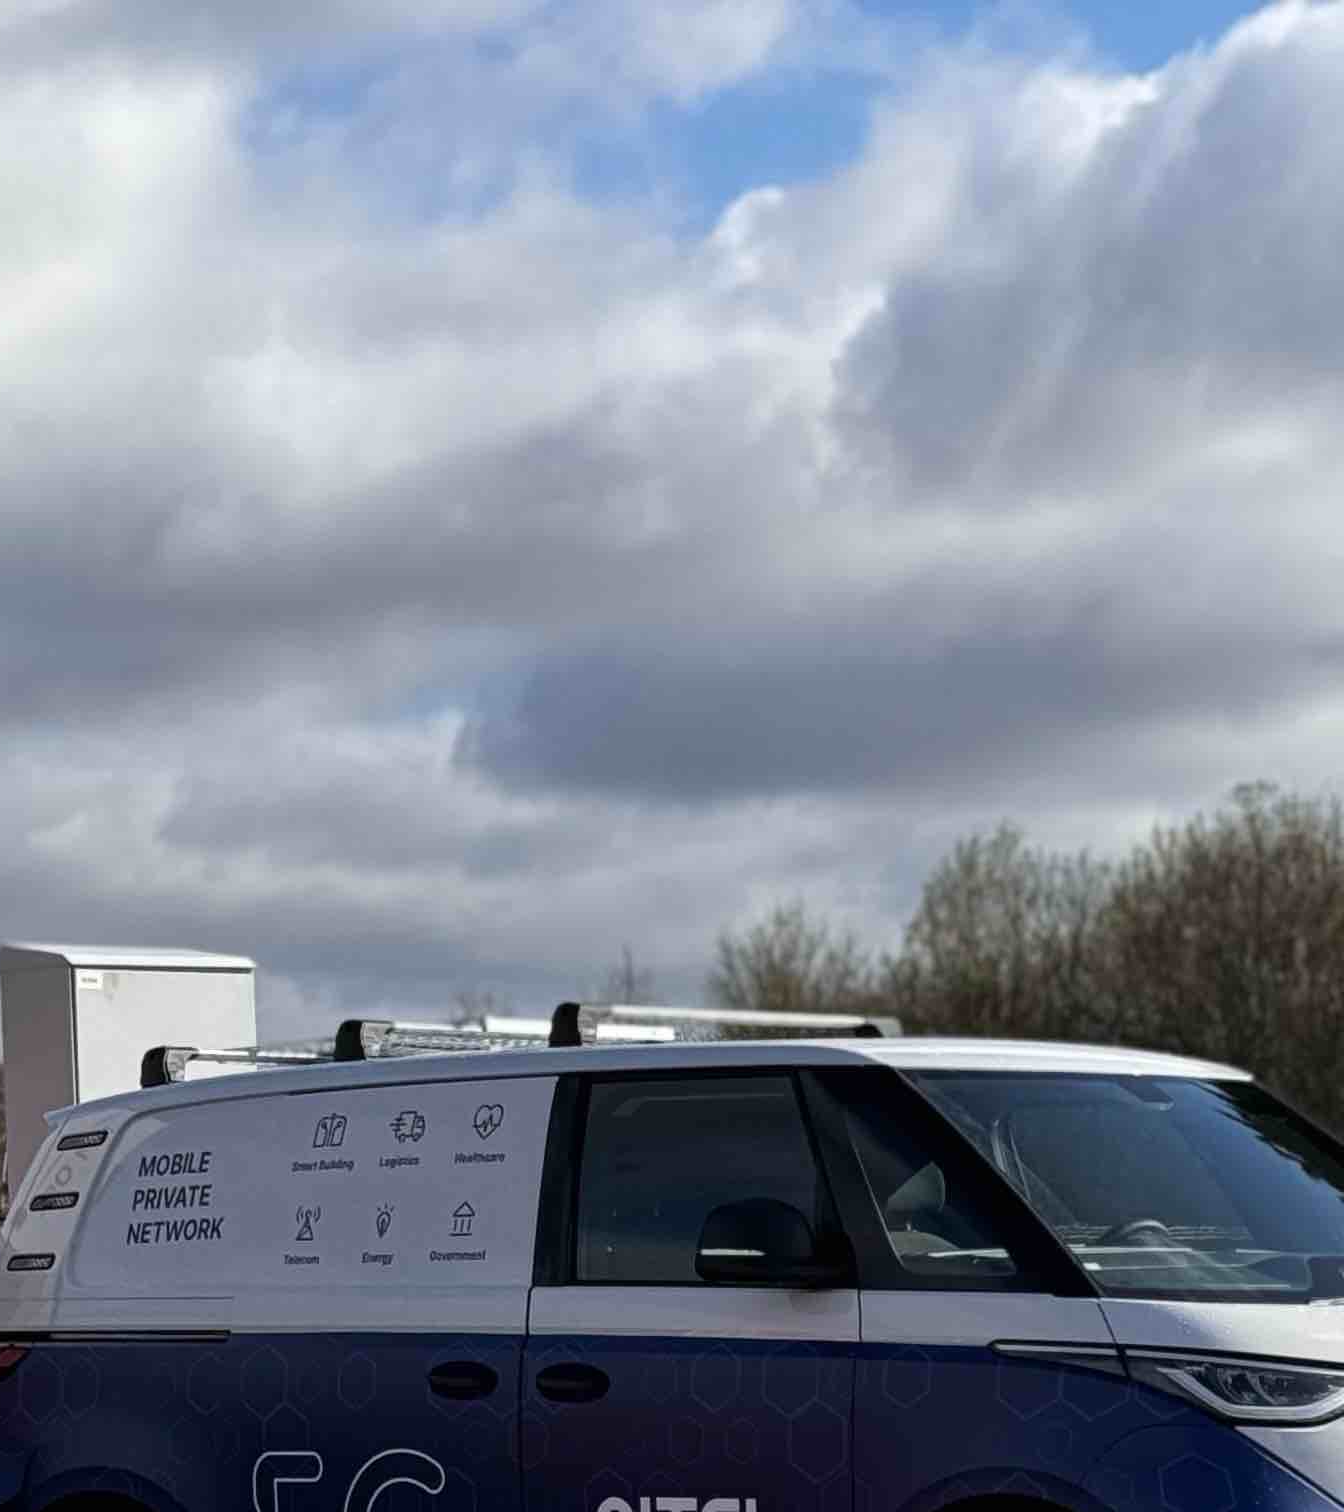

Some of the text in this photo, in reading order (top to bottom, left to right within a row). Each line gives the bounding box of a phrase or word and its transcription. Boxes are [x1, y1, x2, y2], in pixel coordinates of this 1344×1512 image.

[138, 1151, 212, 1178] MOBILE
[319, 1159, 355, 1171] Building
[378, 1156, 421, 1169] Logistics
[453, 1152, 506, 1165] Healthcare
[131, 1183, 212, 1212] PRIVATE
[126, 1216, 225, 1246] NETWORK
[283, 1254, 321, 1266] Telecom
[361, 1252, 395, 1266] Energy
[429, 1250, 487, 1262] Government
